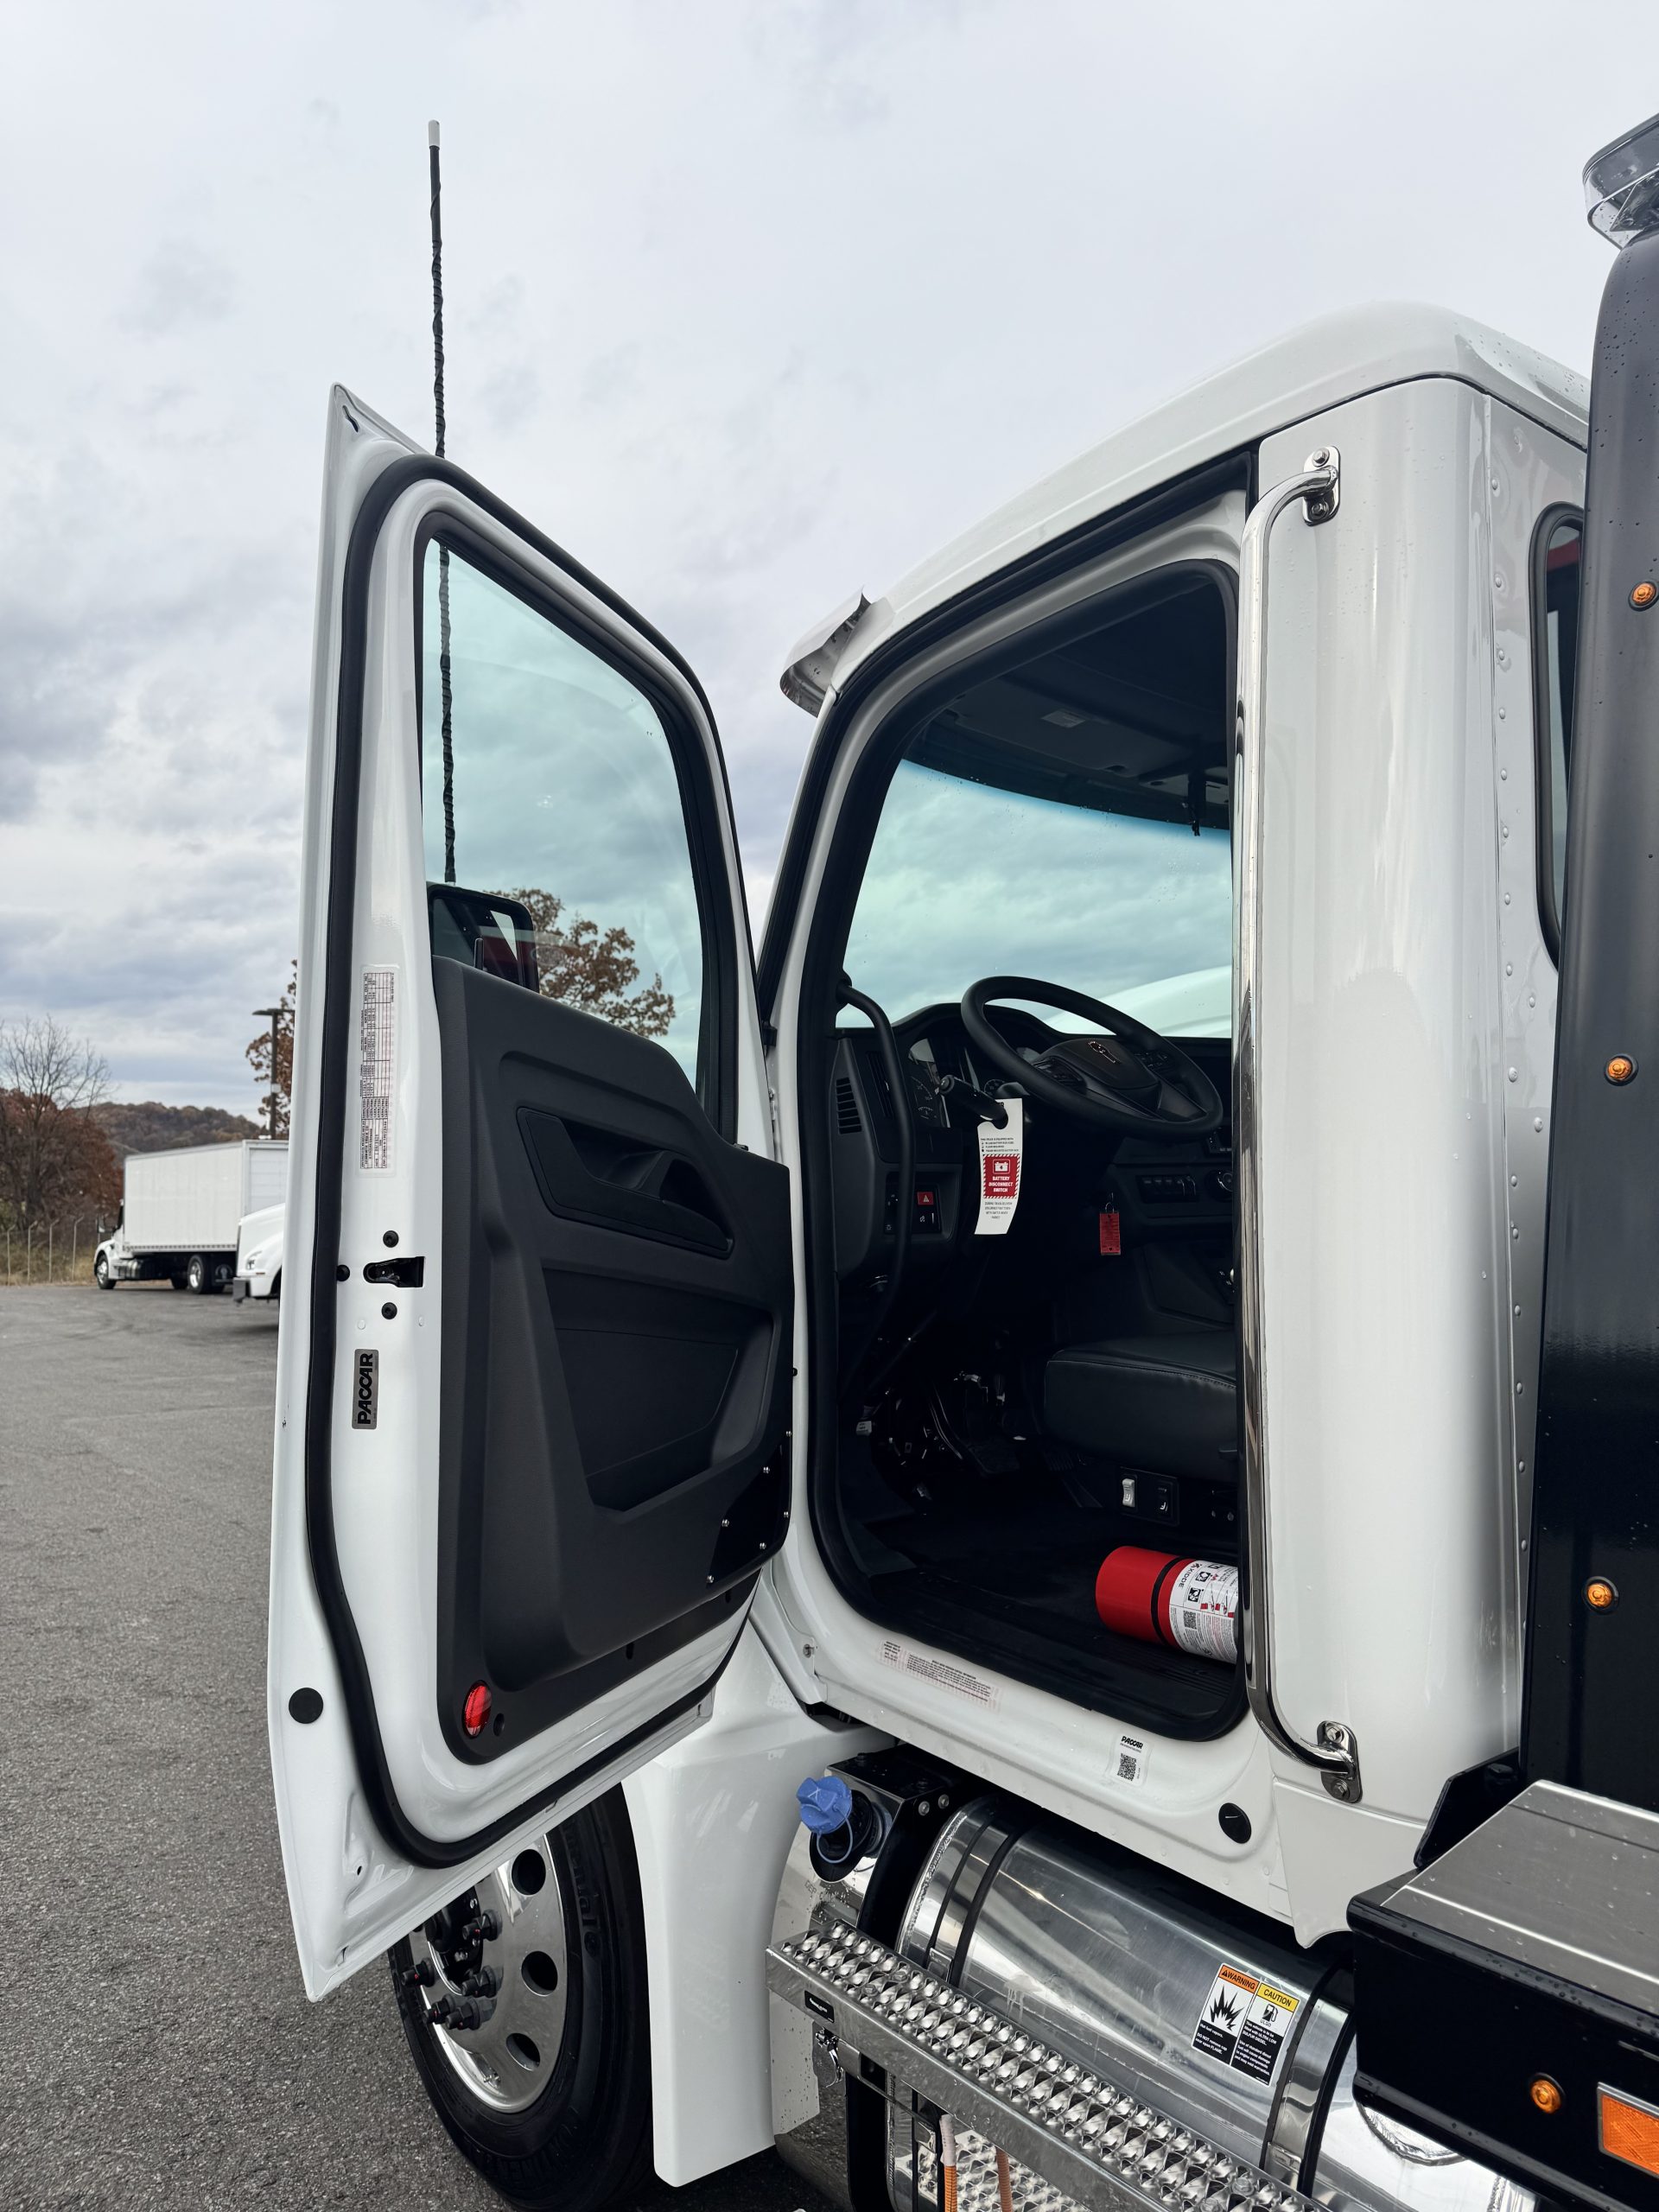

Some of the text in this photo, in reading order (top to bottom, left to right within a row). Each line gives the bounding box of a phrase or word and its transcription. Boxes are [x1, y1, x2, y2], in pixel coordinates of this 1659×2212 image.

[358, 1353, 373, 1425] PACCAR
[1179, 1568, 1195, 1588] KIDDE
[1121, 1736, 1143, 1749] PACCAR
[1227, 1971, 1255, 1990] WARNING
[1263, 1989, 1293, 2007] CAUTION
